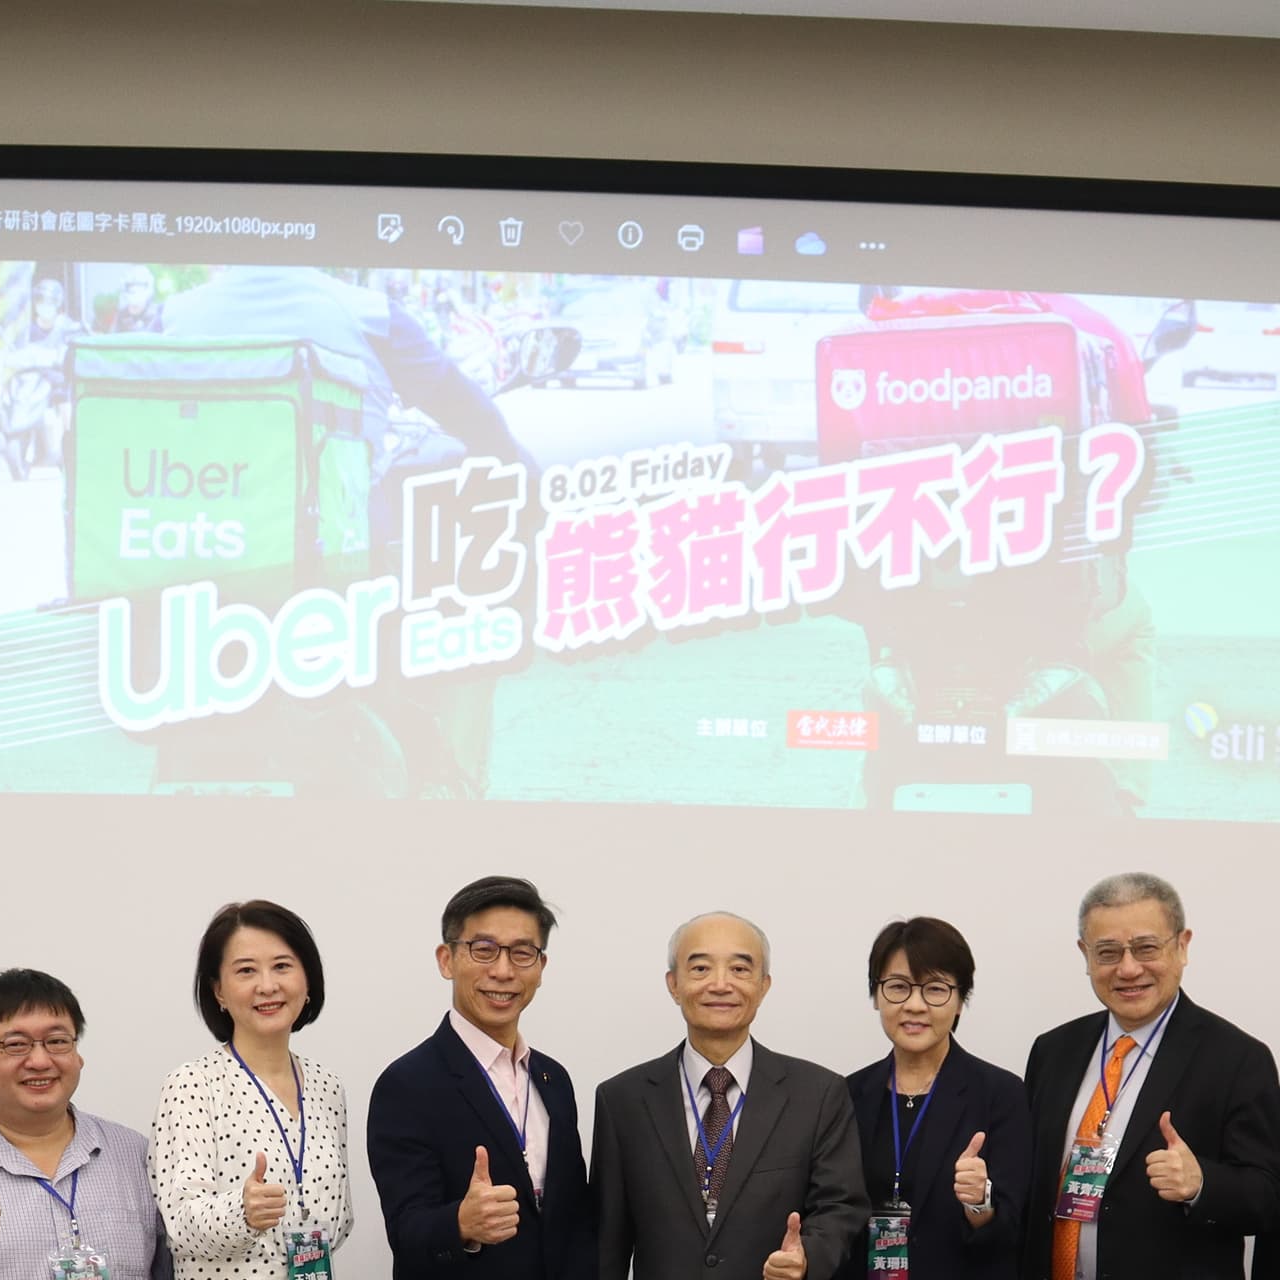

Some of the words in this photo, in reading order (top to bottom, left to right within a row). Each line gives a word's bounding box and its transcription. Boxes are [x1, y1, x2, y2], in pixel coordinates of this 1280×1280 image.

[876, 366, 1053, 410] foodpanda
[121, 447, 249, 500] Uber
[547, 465, 619, 504] 8.02
[629, 448, 726, 492] Friday
[120, 507, 246, 560] Eats
[410, 463, 523, 602] 吃
[540, 430, 1145, 645] 熊貓行不行？
[103, 584, 397, 726] Uber
[408, 610, 519, 670] Eats
[1210, 722, 1265, 762] stli
